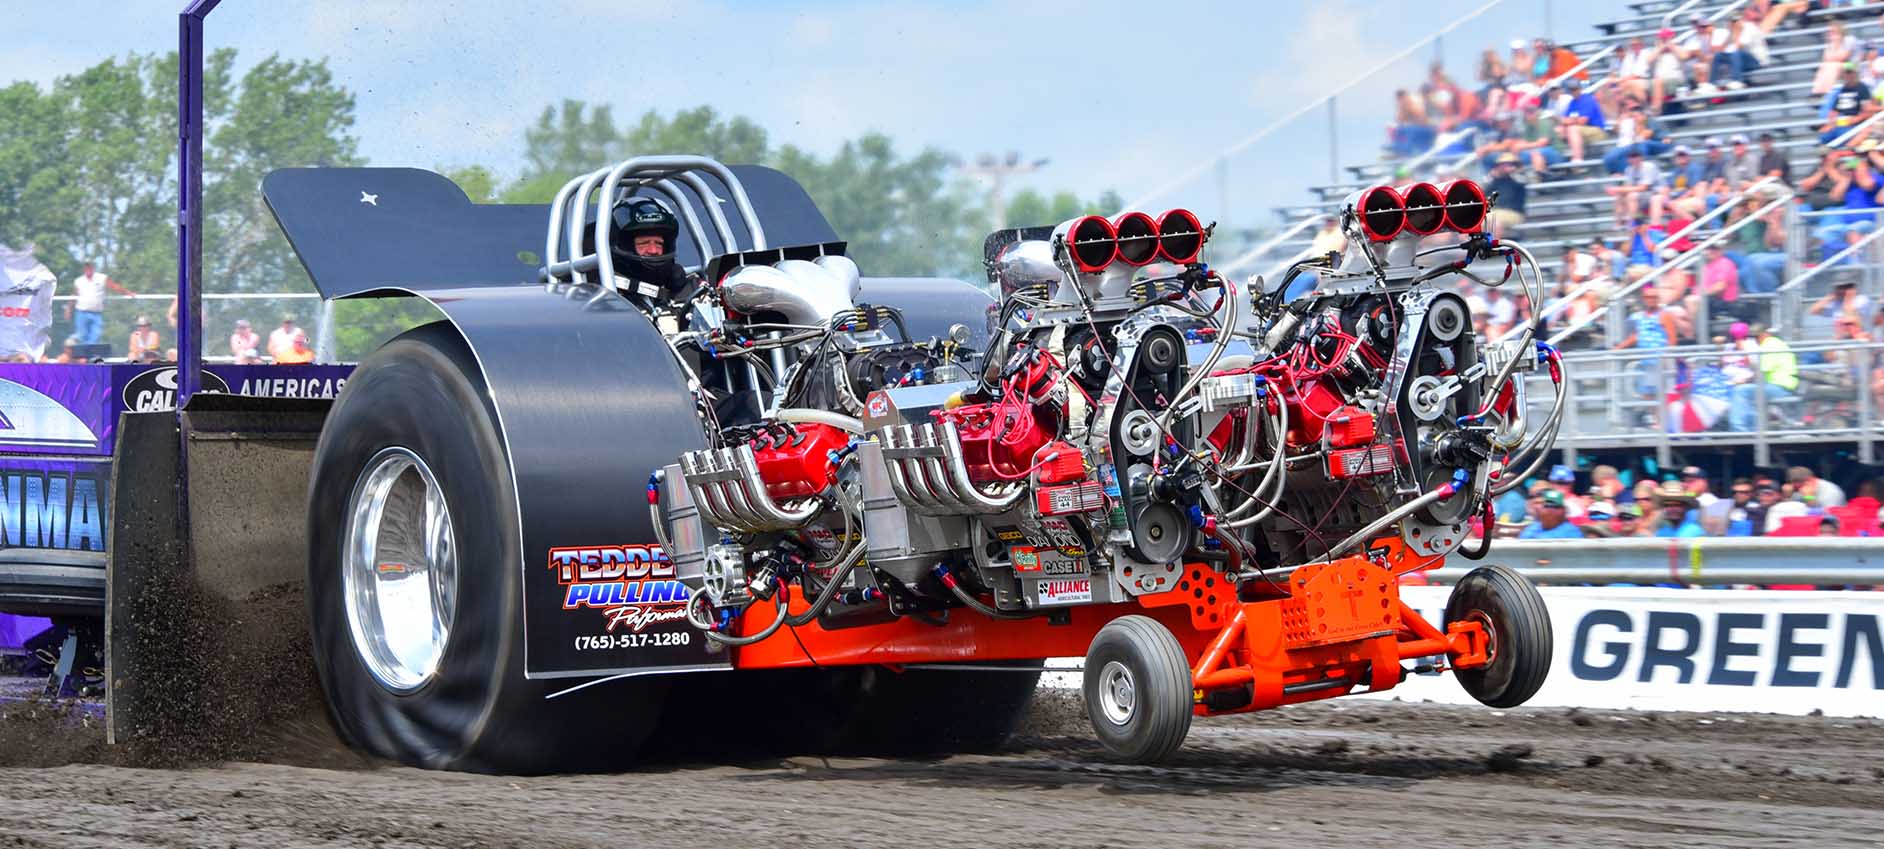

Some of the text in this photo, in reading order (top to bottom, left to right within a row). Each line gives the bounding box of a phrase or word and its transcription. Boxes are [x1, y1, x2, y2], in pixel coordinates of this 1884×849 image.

[0, 473, 111, 550] NMA
[552, 546, 674, 580] TEDDE
[1044, 561, 1073, 575] CASE
[1048, 580, 1089, 597] ALLIANCE
[574, 632, 690, 650] (765)-517-1280
